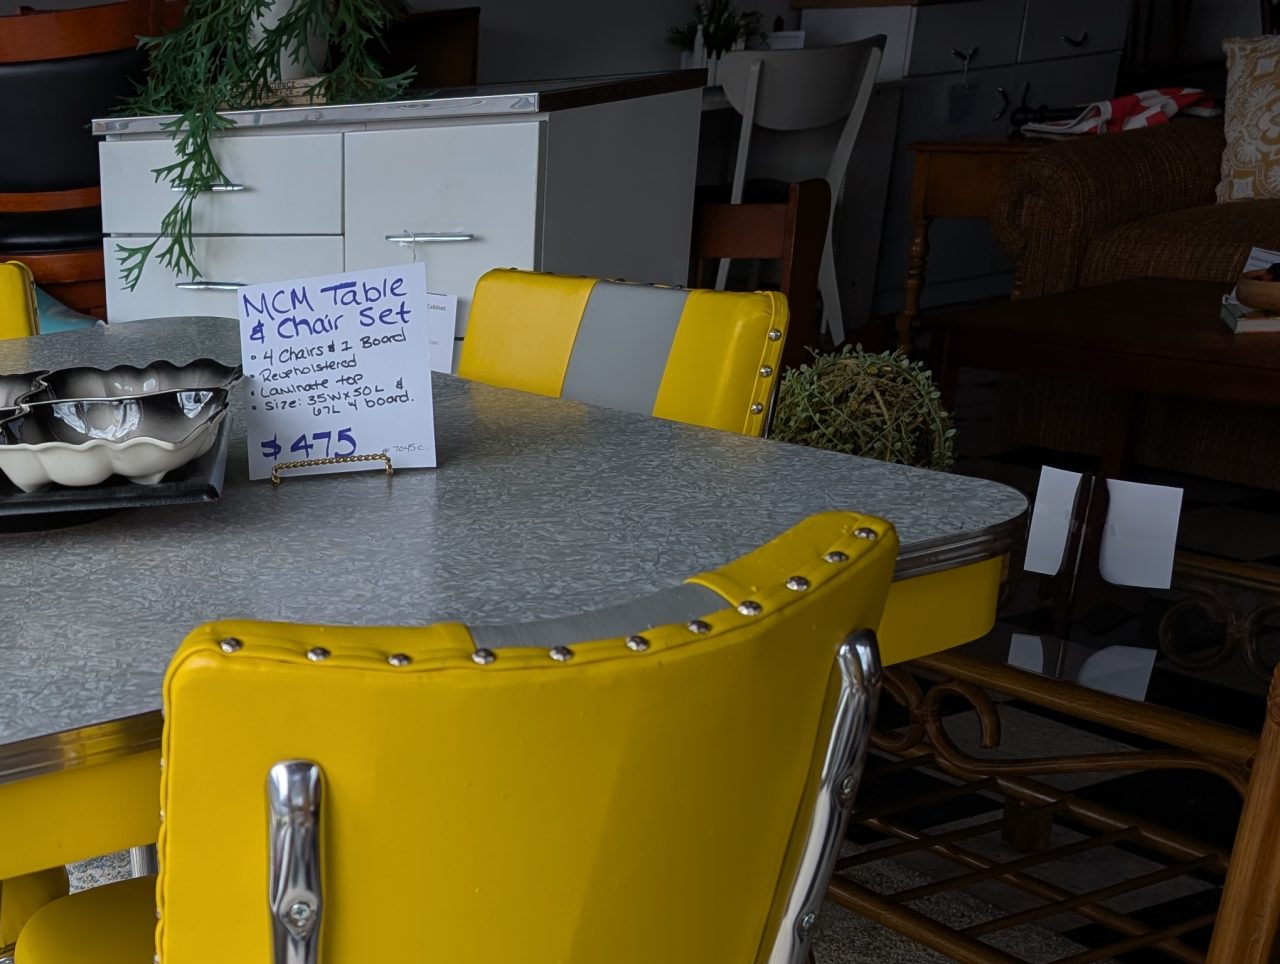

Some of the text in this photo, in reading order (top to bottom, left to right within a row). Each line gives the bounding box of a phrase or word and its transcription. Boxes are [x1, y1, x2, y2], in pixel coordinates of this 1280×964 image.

[242, 277, 408, 321] MCM Table
[249, 319, 265, 344] &
[359, 301, 412, 327] Set
[263, 349, 273, 366] 4
[278, 345, 324, 364] Chairs
[360, 326, 407, 349] Board
[335, 373, 363, 386] top
[261, 427, 357, 460] $475
